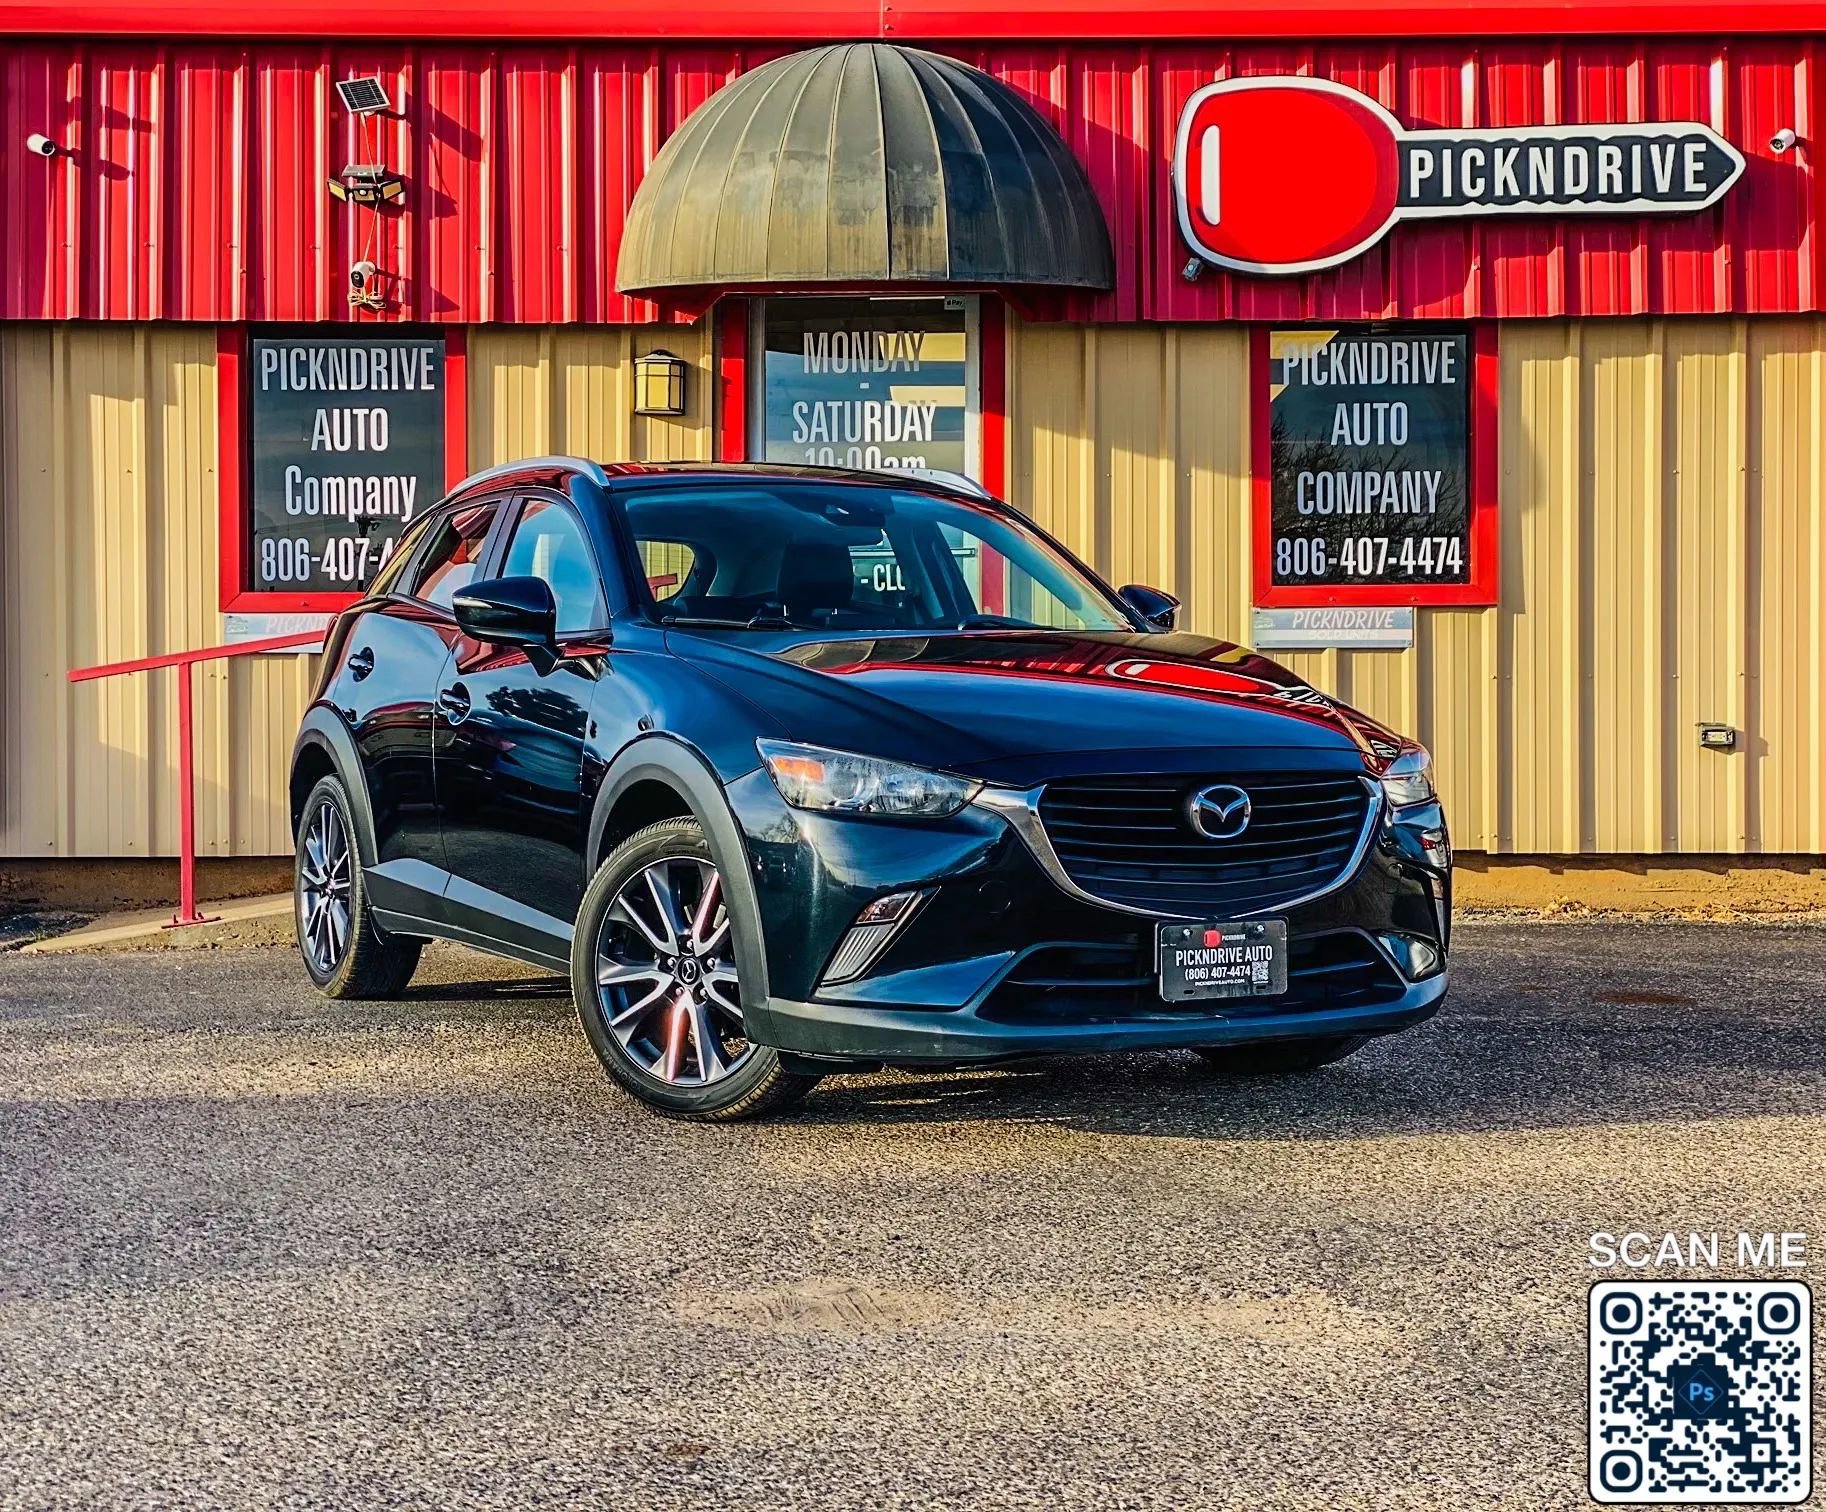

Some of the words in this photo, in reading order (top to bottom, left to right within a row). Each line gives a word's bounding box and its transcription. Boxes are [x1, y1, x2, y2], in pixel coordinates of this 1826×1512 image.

[1409, 142, 1708, 198] PICKNDRIVE
[261, 347, 435, 391] PICKNDRIVE
[803, 331, 925, 374] MONDAY
[1282, 341, 1456, 386] PICKNDRIVE
[311, 408, 389, 451] AUTO
[792, 400, 937, 444] SATURDAY
[1331, 402, 1408, 446] AUTO
[285, 465, 417, 522] Company
[1297, 470, 1442, 515] COMPANY
[1276, 536, 1463, 576] 806-407-4474
[1292, 609, 1396, 629] PICKNDRIVE
[1175, 947, 1243, 967] PICKNDRIVE
[1244, 945, 1273, 962] AUTO
[1184, 968, 1209, 981] (806)
[1210, 965, 1251, 979] 407-4474
